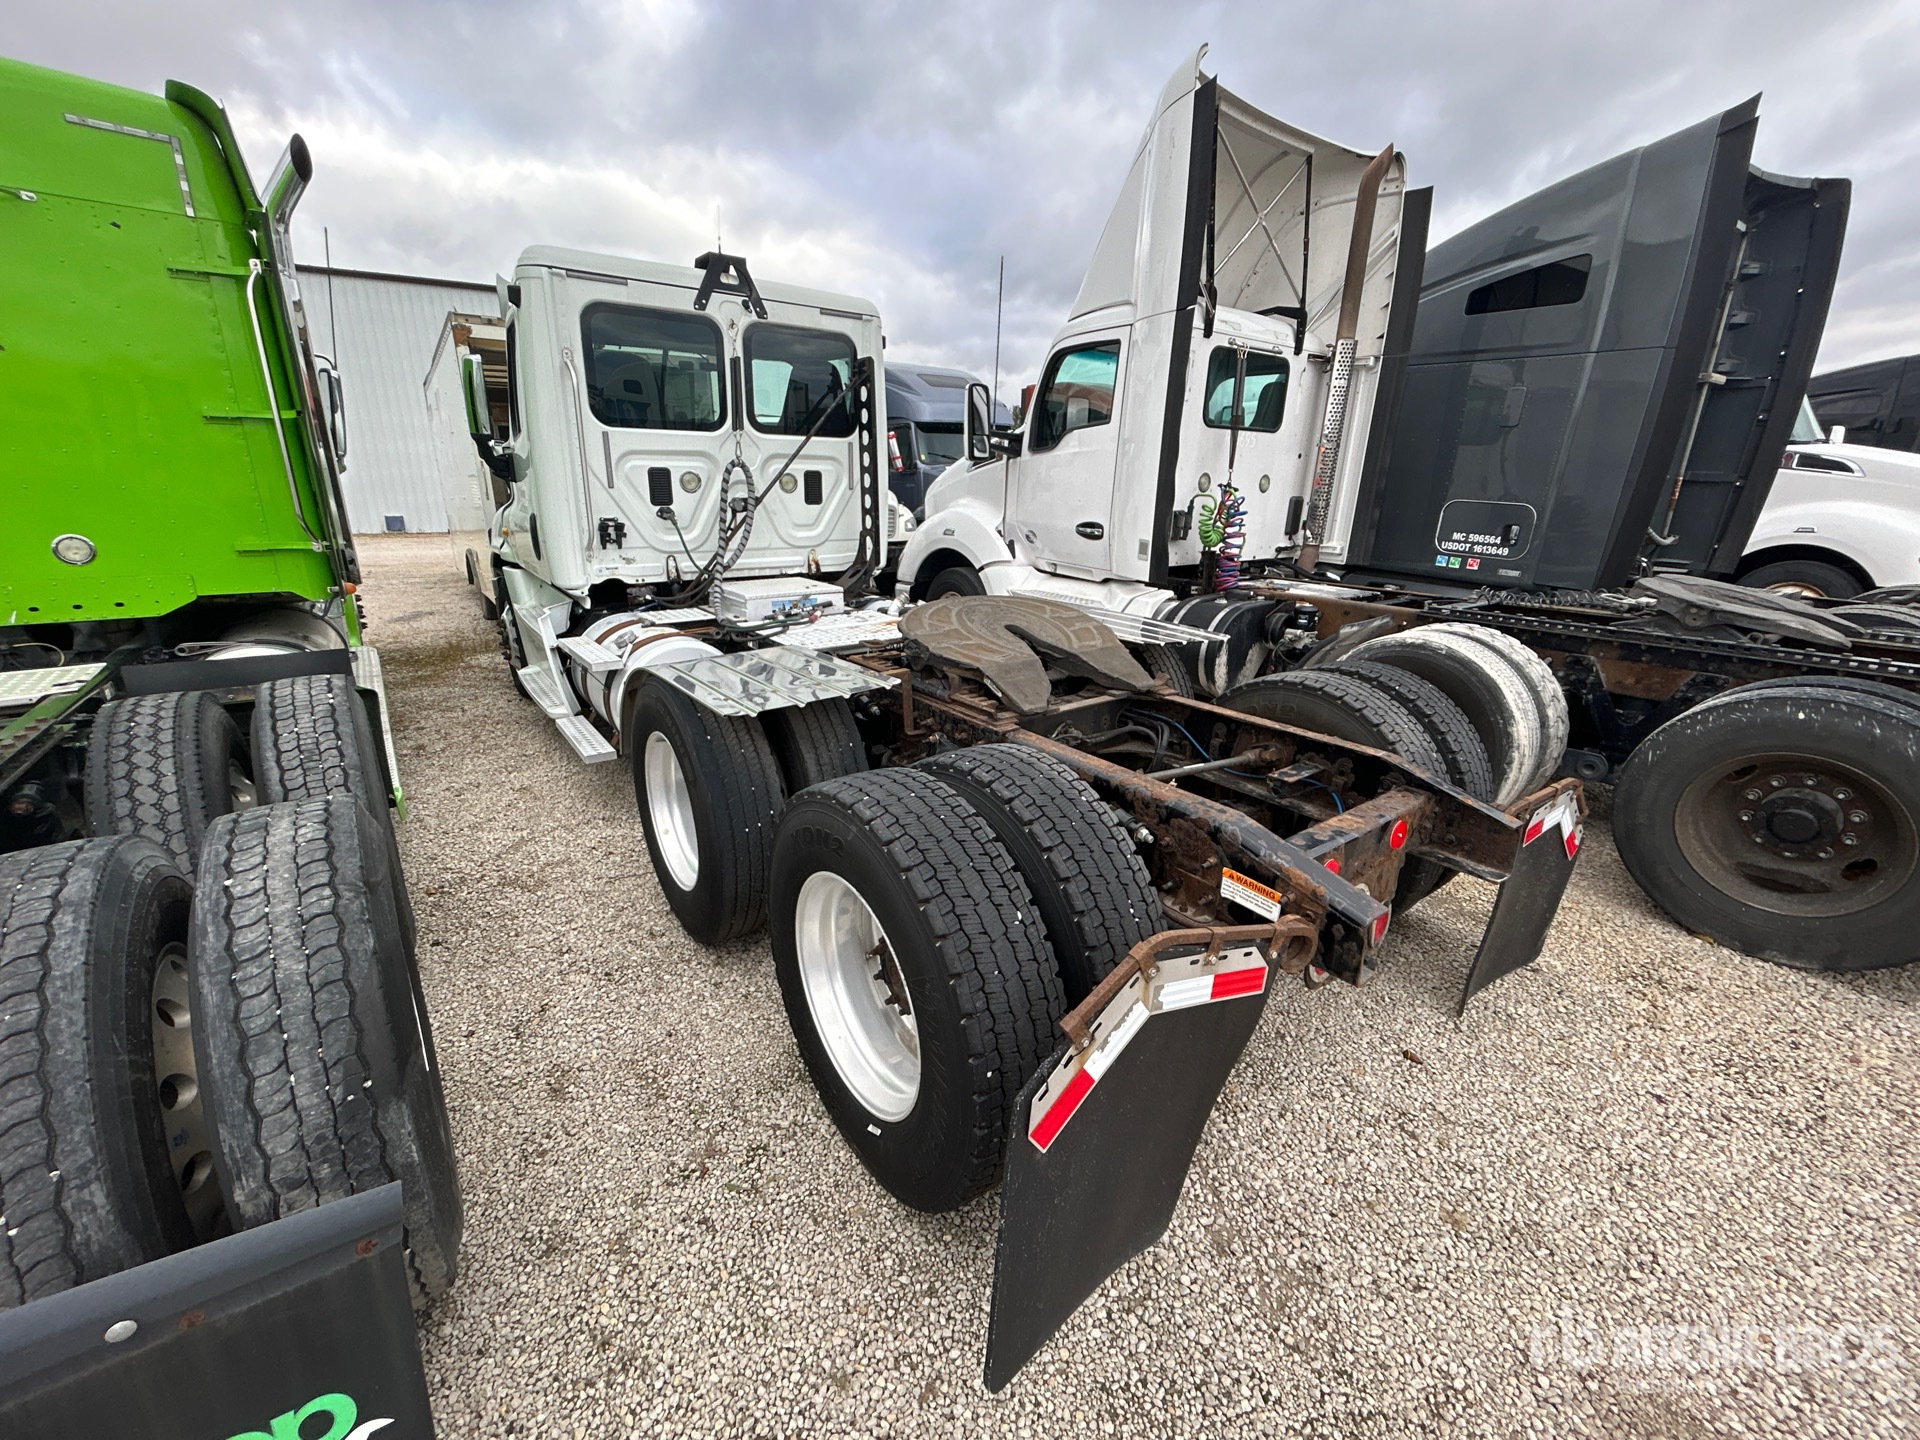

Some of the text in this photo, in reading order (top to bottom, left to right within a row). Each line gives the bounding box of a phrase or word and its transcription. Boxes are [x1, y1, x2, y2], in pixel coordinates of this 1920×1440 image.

[1452, 532, 1501, 544] MC 596564
[1441, 541, 1509, 555] USDOT 1613649
[1236, 873, 1276, 900] WARNING
